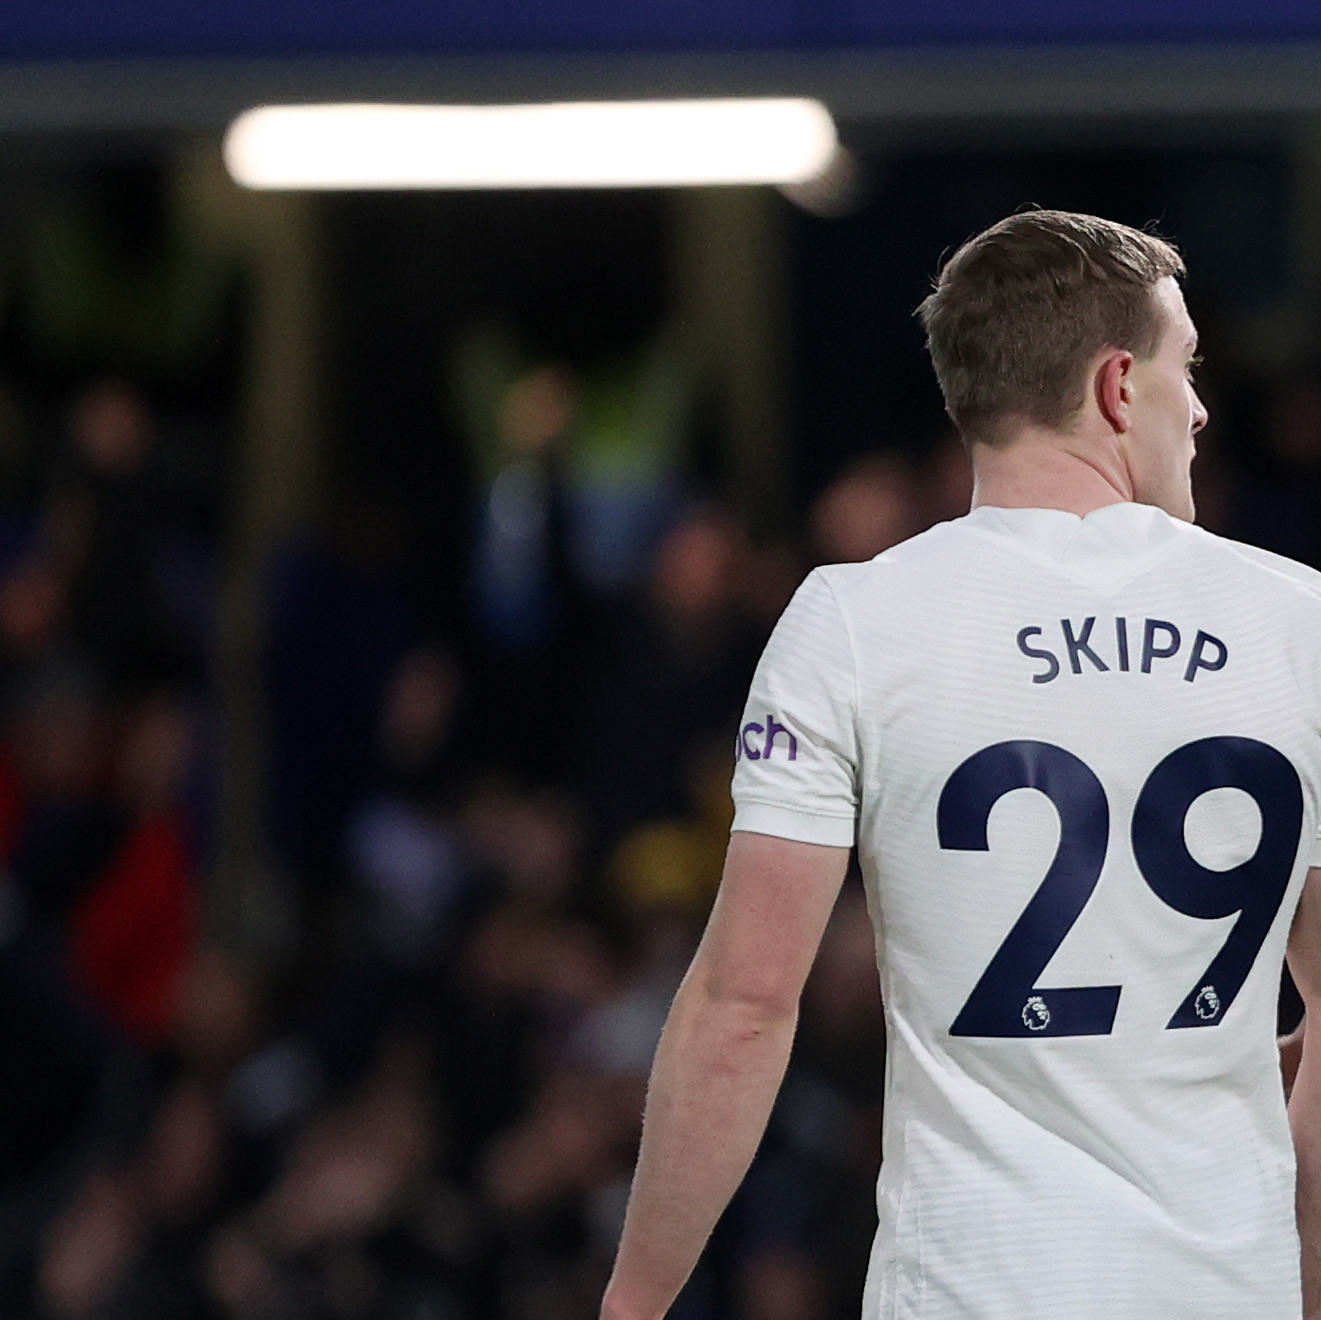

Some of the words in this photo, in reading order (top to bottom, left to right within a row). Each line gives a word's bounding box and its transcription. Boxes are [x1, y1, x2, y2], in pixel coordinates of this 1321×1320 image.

[1016, 616, 1229, 684] SKIPP
[736, 714, 797, 761] ch
[937, 736, 1304, 1037] 29
